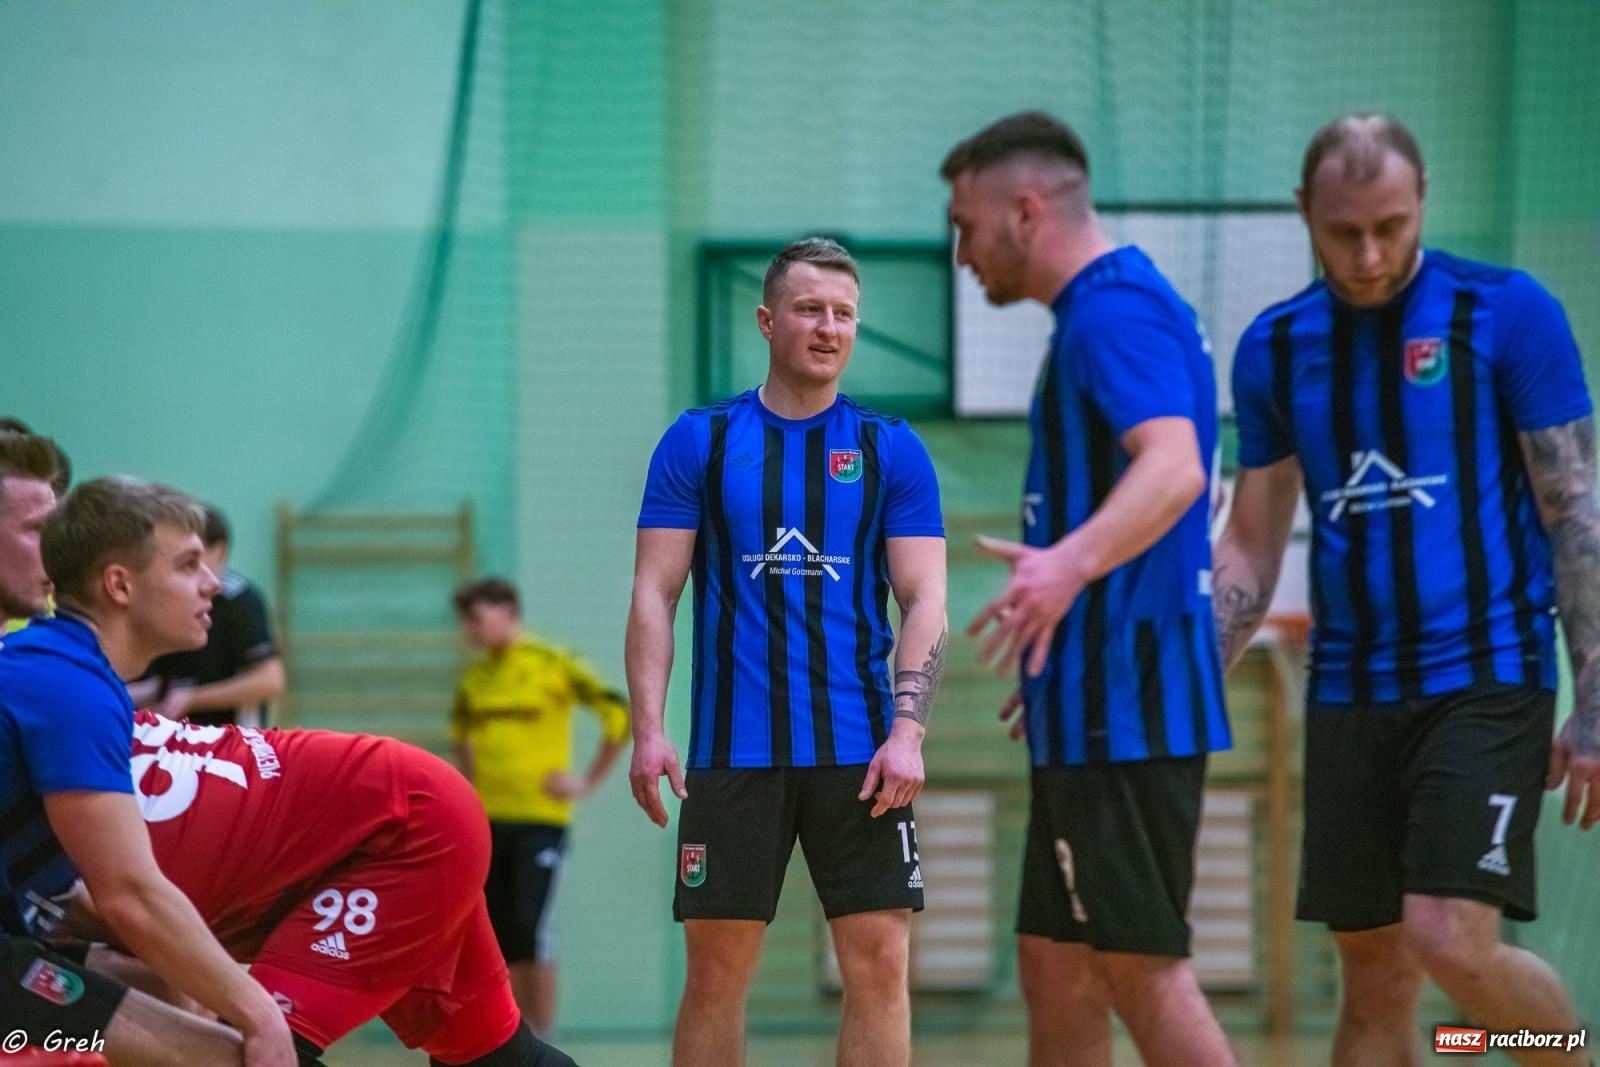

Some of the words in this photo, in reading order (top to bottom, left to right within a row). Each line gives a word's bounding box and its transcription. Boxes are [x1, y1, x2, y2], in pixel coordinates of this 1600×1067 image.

[765, 553, 801, 562] DEKARSKO
[807, 554, 850, 565] BLACHARSKIE
[1488, 793, 1518, 845] 7
[312, 888, 378, 935] 98
[310, 943, 350, 961] adidas
